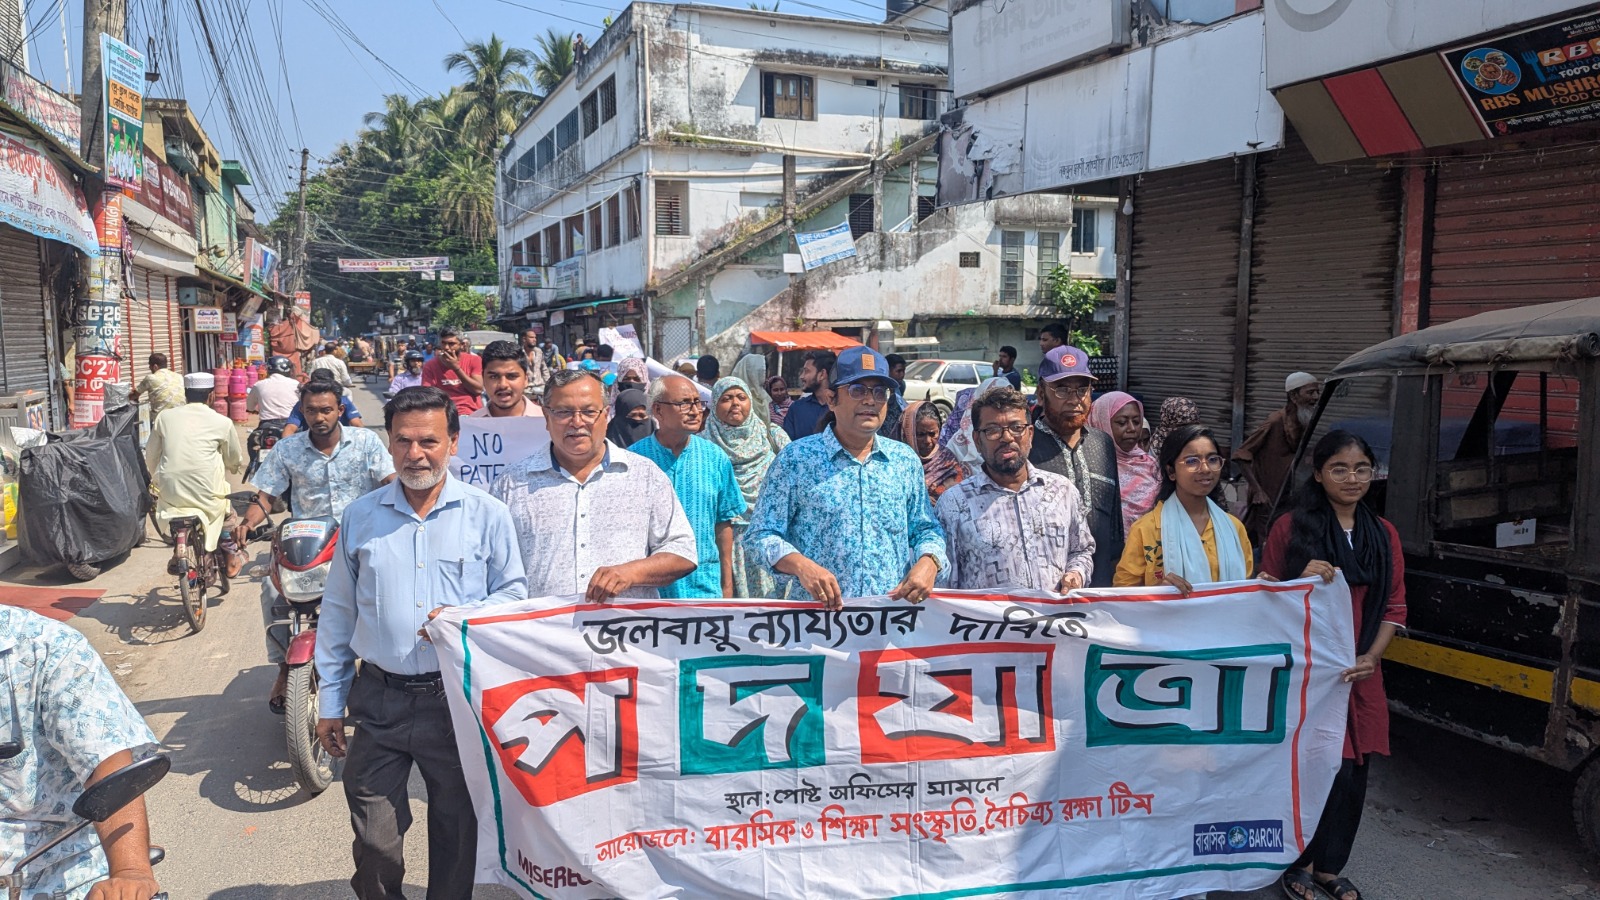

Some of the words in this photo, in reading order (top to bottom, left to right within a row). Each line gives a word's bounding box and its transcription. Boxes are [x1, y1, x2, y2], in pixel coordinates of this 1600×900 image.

[1480, 93, 1520, 111] RBS
[1551, 92, 1589, 106] FOOD
[470, 433, 503, 459] NO
[583, 615, 740, 654] জলবায়ু
[950, 606, 1088, 641] দাবিতে
[829, 773, 917, 800] অফিসের
[927, 777, 1005, 798] সামনে
[704, 809, 795, 851] বারসিক
[801, 821, 814, 840] ও
[817, 804, 883, 841] শিক্ষা
[1059, 796, 1103, 821] রক্ষা
[1108, 781, 1155, 816] টিম
[1195, 825, 1227, 853] বারসিক
[1249, 827, 1283, 848] BARCIK
